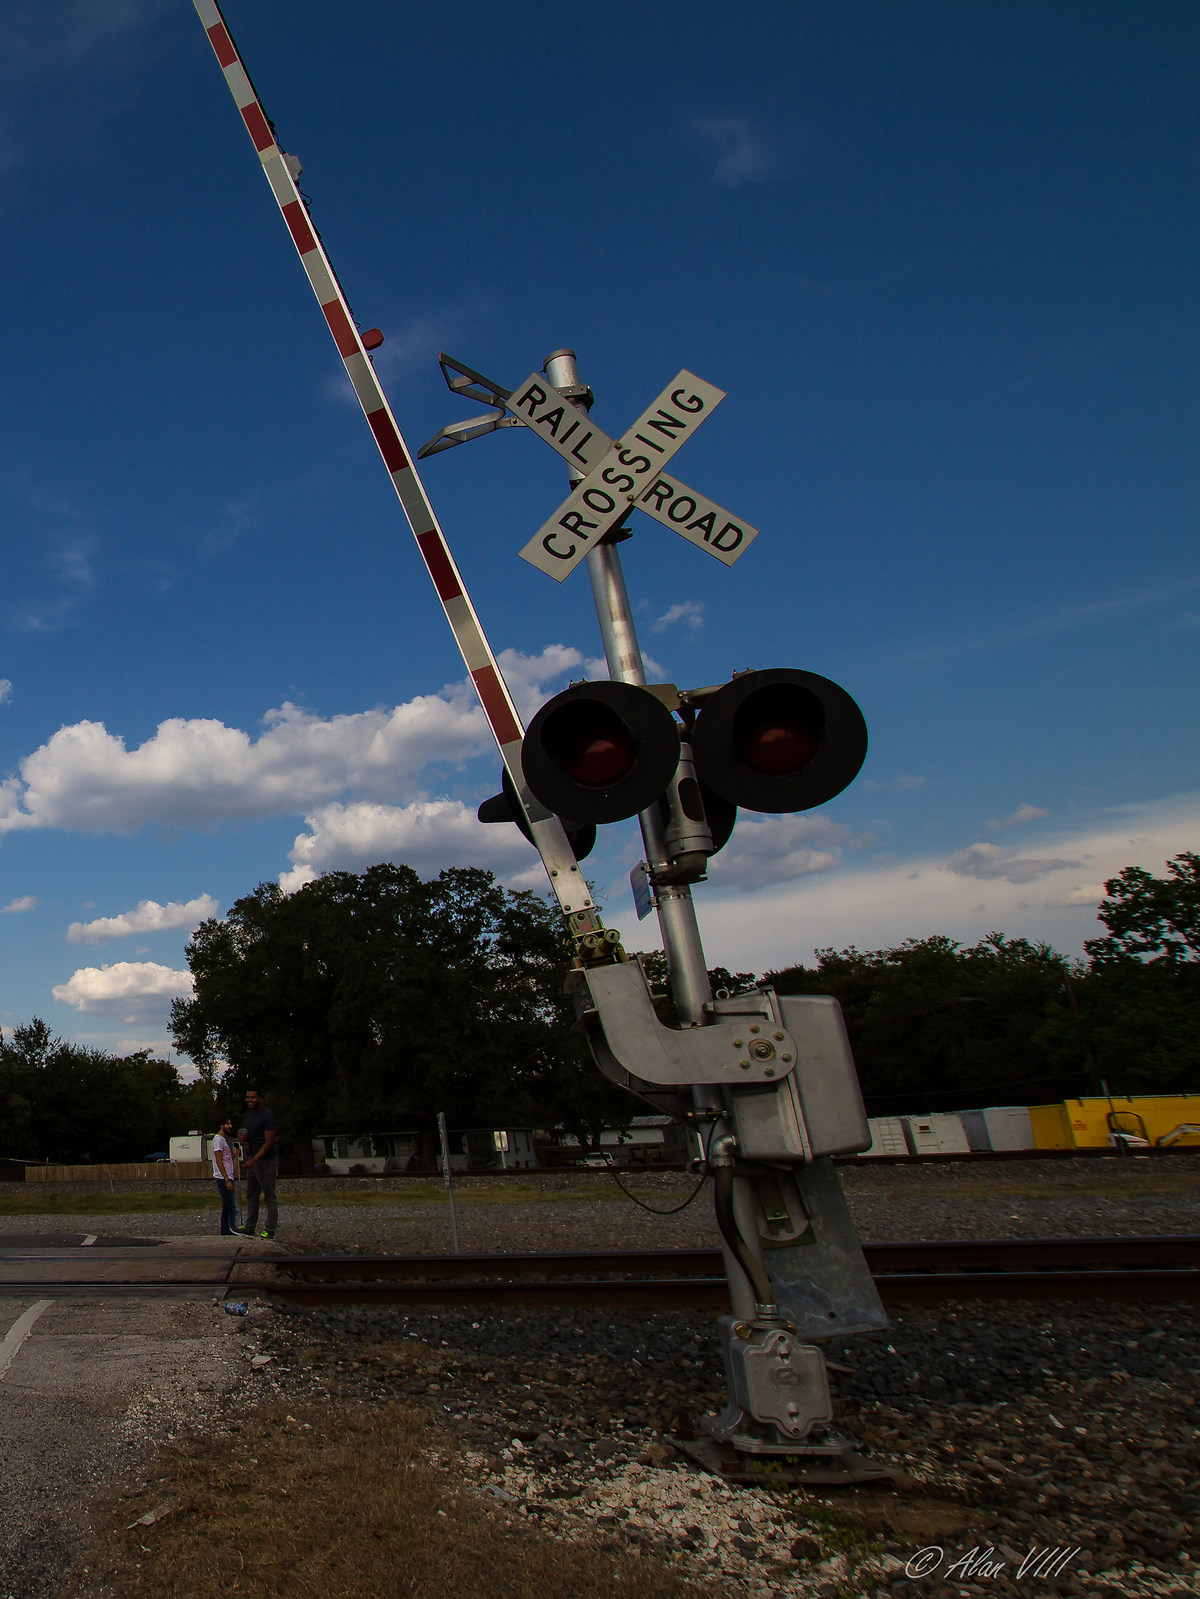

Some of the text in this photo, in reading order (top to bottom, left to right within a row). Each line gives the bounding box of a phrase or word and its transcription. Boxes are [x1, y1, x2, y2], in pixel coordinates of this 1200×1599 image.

[516, 383, 744, 552] RAIL ROAD
[542, 388, 704, 560] CROSSING
